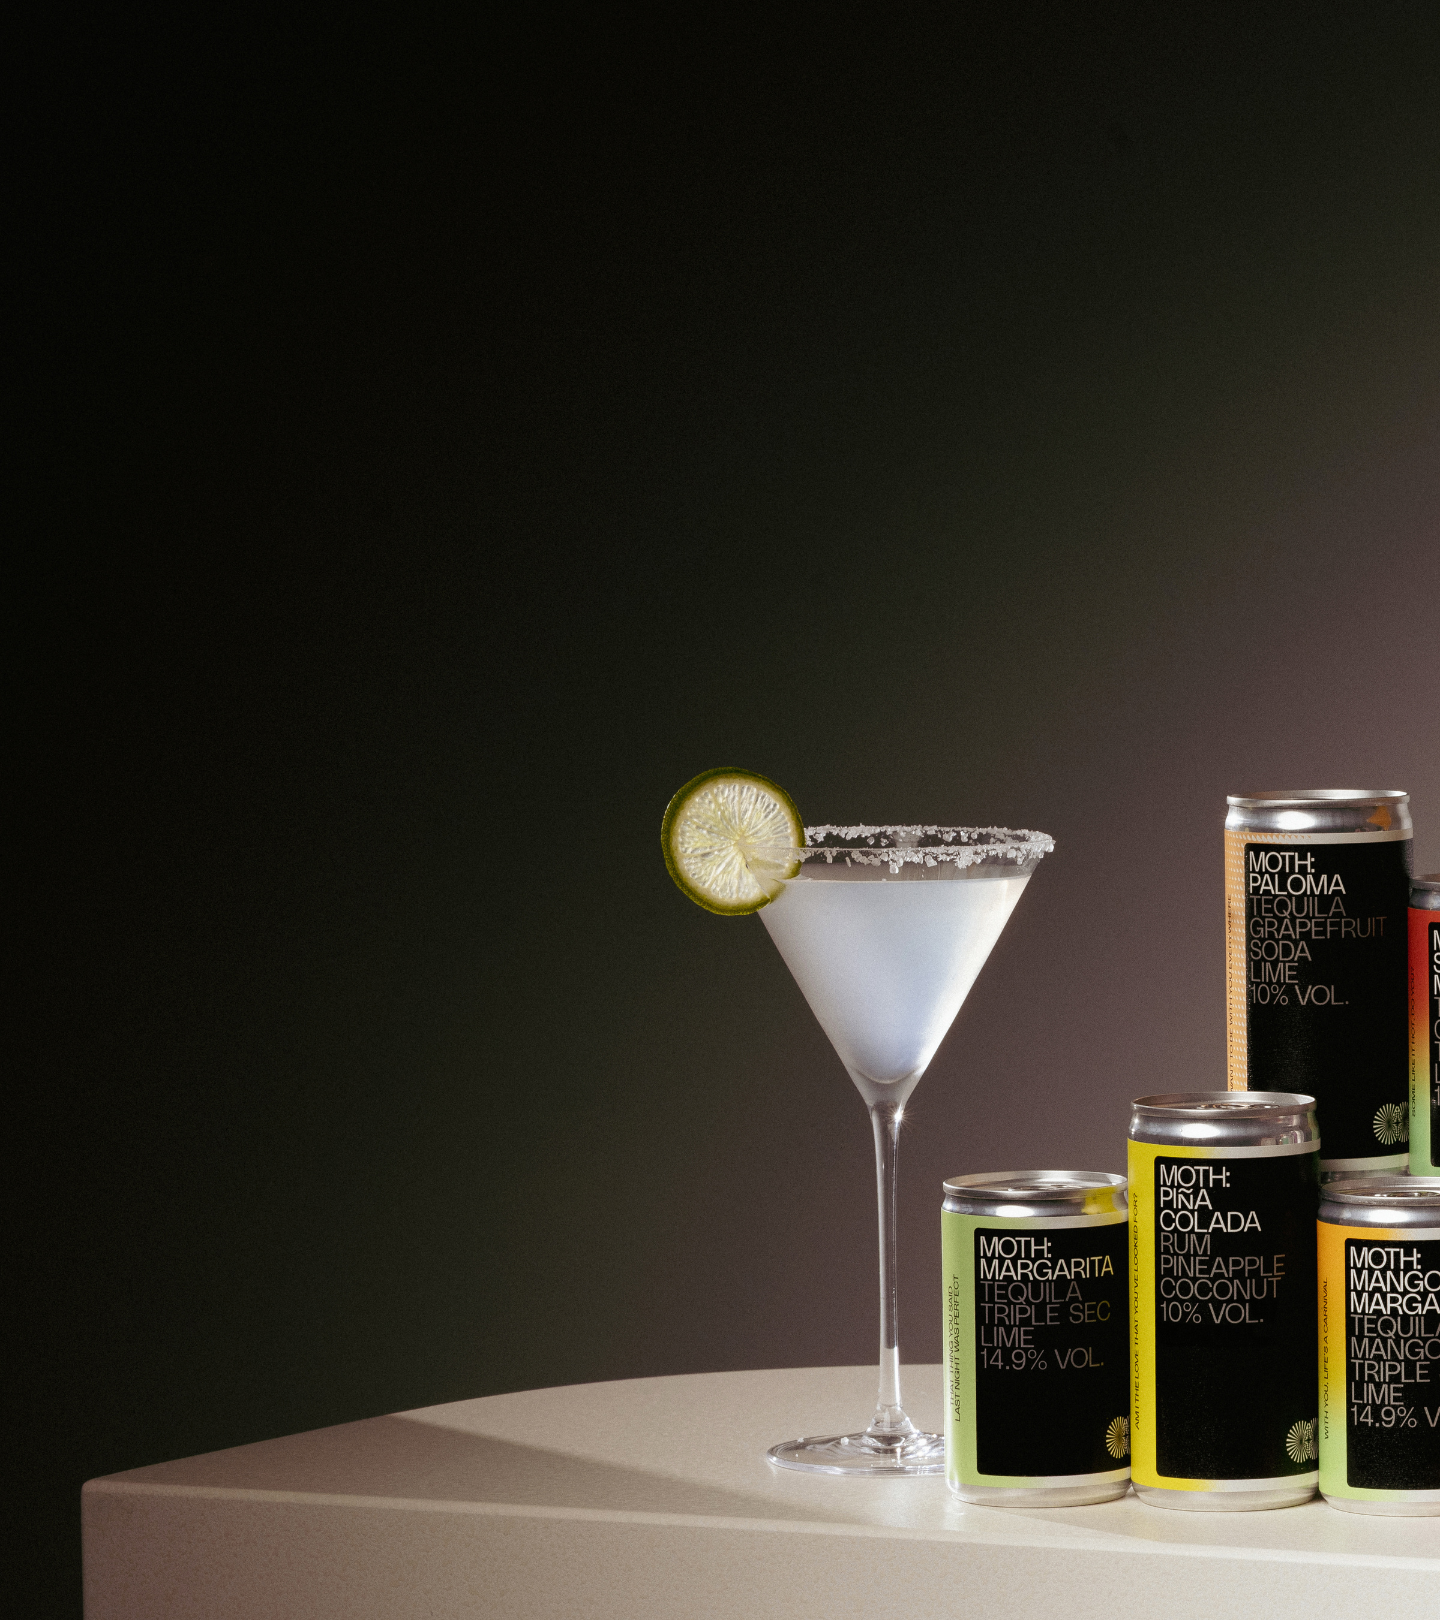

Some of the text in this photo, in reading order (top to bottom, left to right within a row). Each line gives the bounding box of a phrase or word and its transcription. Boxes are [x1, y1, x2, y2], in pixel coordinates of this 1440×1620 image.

[1250, 851, 1315, 873] MOTH:
[1249, 873, 1346, 895] PALOMA
[1249, 895, 1346, 918] TEQUILA
[1250, 917, 1386, 939] GRAPEFRUIT
[1249, 940, 1311, 961] SODA
[1251, 962, 1298, 983] LIME
[1250, 984, 1348, 1005] 10% VOL.
[1160, 1164, 1230, 1187] MOTH:
[1161, 1187, 1212, 1209] PIÑA
[1160, 1210, 1261, 1232] COLADA
[980, 1236, 1051, 1258] MOTH:
[1161, 1232, 1210, 1254] RUM
[981, 1256, 1113, 1280] MARGARITA
[1161, 1254, 1285, 1277] PINEAPPLE
[1351, 1246, 1421, 1269] MOTH:
[980, 1281, 1082, 1304] TEQUILA
[1161, 1277, 1281, 1300] COCONUT
[981, 1301, 1110, 1325] TRIPLE SEC
[1161, 1301, 1263, 1323] 10% VOL.
[982, 1326, 1034, 1347] LIME
[981, 1347, 1103, 1370] 14.9% VOL.
[1351, 1360, 1430, 1382] TRIPLE
[1352, 1383, 1404, 1405] LIME
[1135, 1411, 1140, 1430] AM
[1351, 1405, 1417, 1428] 14.9%
